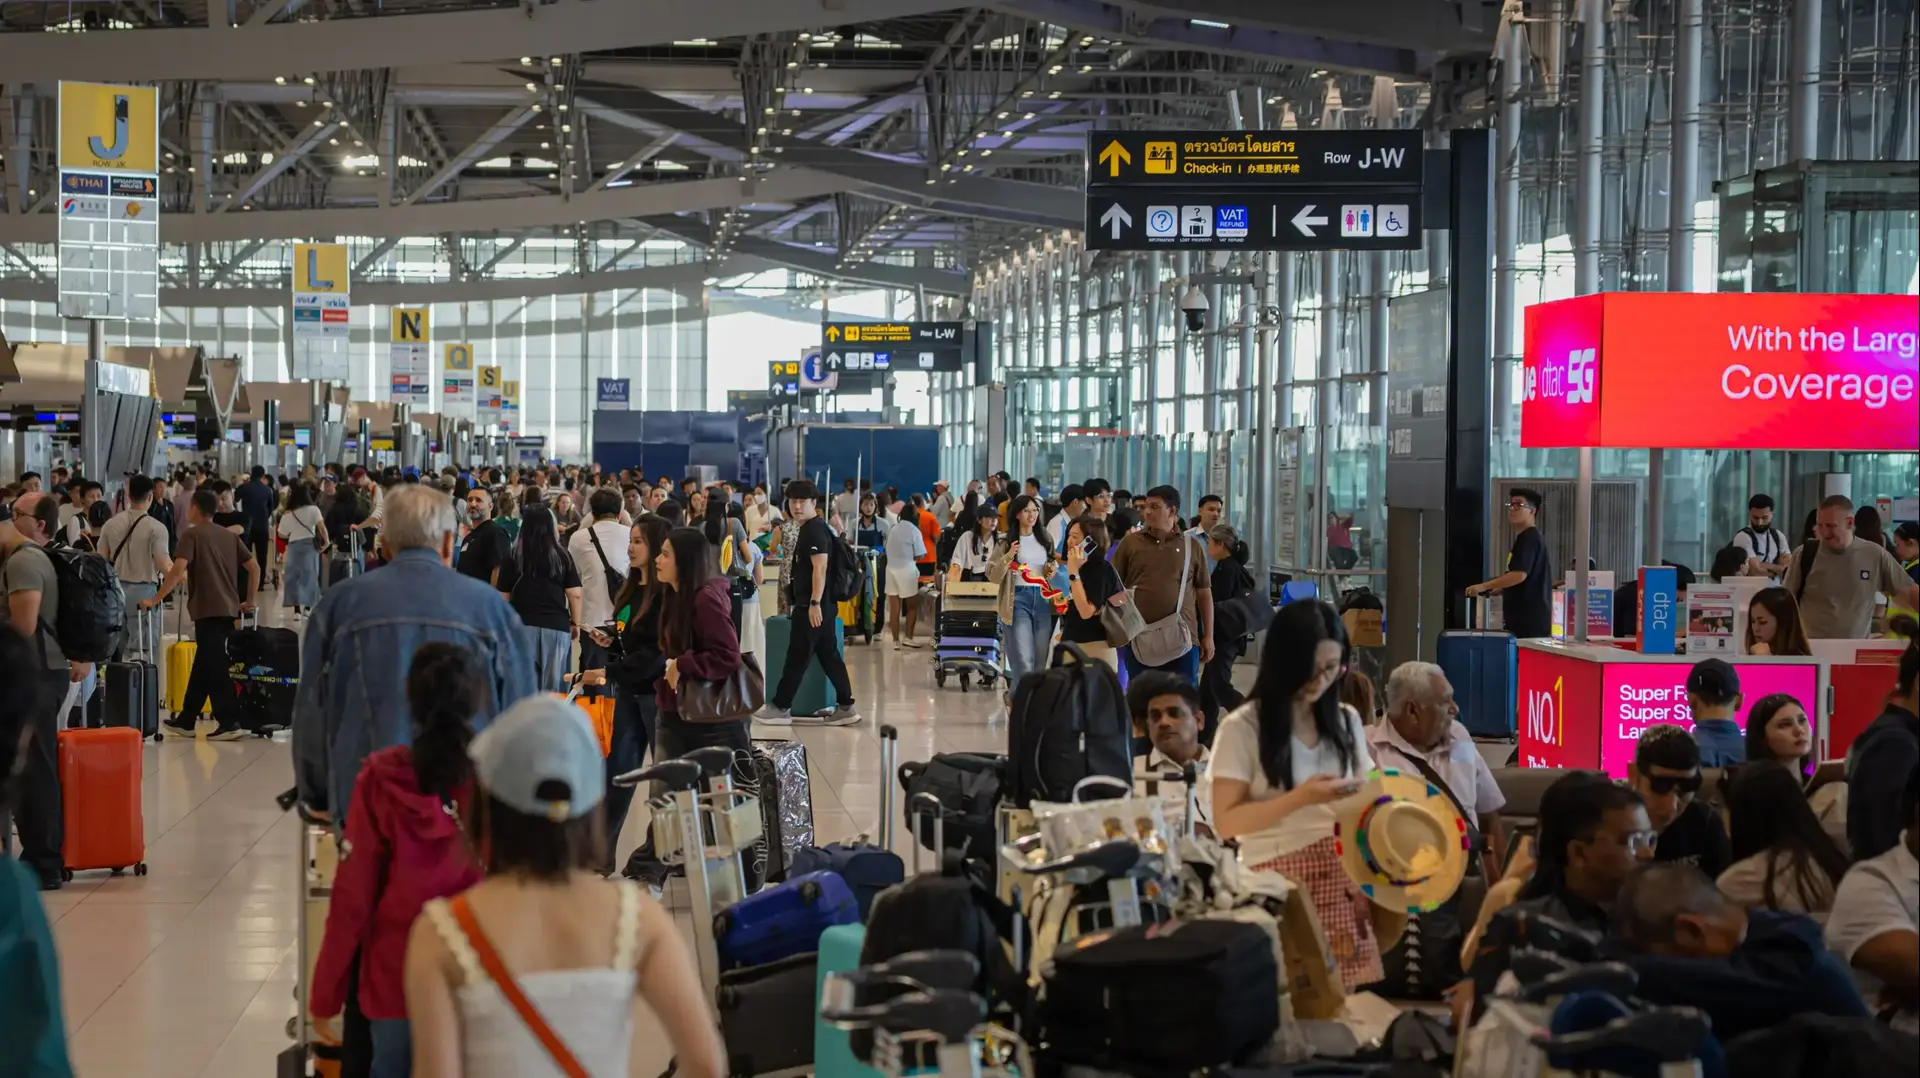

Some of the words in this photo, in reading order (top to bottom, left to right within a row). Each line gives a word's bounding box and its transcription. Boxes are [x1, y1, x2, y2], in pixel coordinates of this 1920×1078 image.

[88, 94, 129, 160] J
[1184, 134, 1295, 153] ตรวจบัตรโดยสาร
[1323, 151, 1351, 164] Row
[1358, 147, 1406, 169] J-W
[1183, 162, 1232, 174] Check-in
[1247, 163, 1300, 174] 办理登机手续
[79, 178, 103, 189] THAI
[1220, 209, 1244, 220] VAT
[308, 249, 334, 288] L
[400, 312, 420, 339] N
[935, 328, 955, 339] L-W
[1727, 325, 1792, 352] With
[1799, 326, 1846, 352] the
[1853, 326, 1919, 358] Larg
[483, 368, 496, 387] S
[1541, 357, 1565, 398] dtac
[1566, 348, 1596, 404] 5G
[503, 382, 515, 398] U
[602, 382, 625, 393] VAT
[1721, 364, 1914, 409] Coverage
[1652, 592, 1671, 630] dtac
[1619, 684, 1671, 704] Super
[1619, 703, 1671, 723] Super
[1618, 723, 1647, 739] Lar
